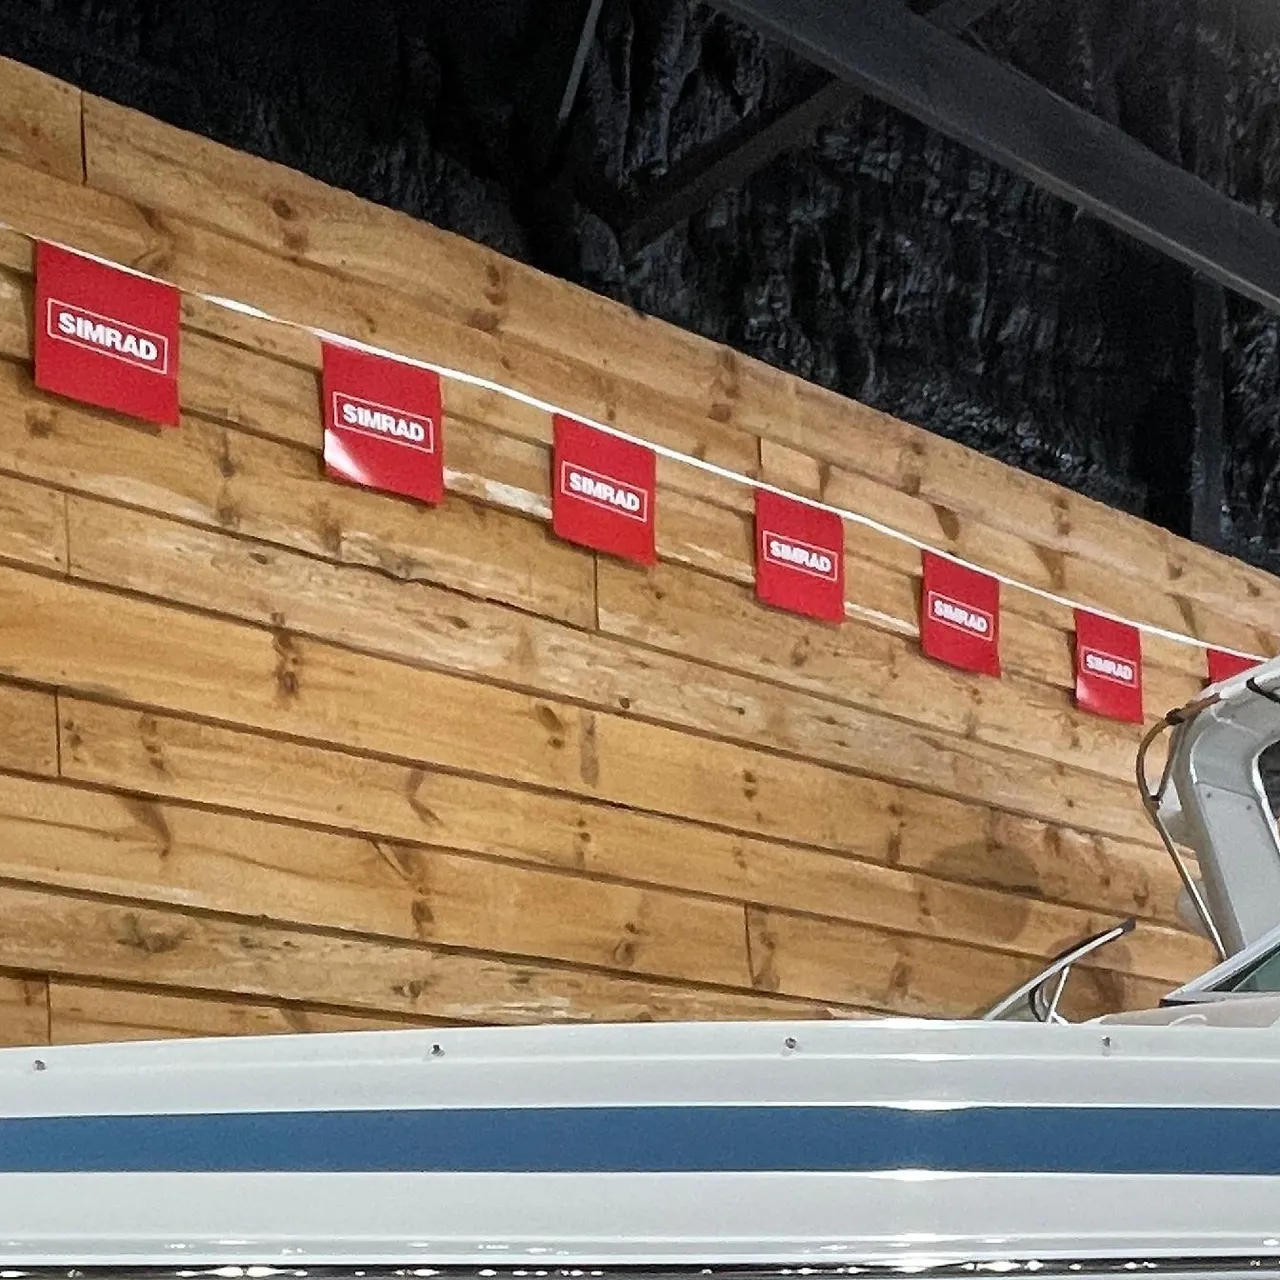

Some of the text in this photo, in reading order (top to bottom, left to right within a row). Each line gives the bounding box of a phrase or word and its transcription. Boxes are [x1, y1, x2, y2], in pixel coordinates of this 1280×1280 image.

[57, 312, 158, 362] SIMRAD
[342, 403, 425, 442] SIMRAD
[569, 472, 640, 512] SIMRAD
